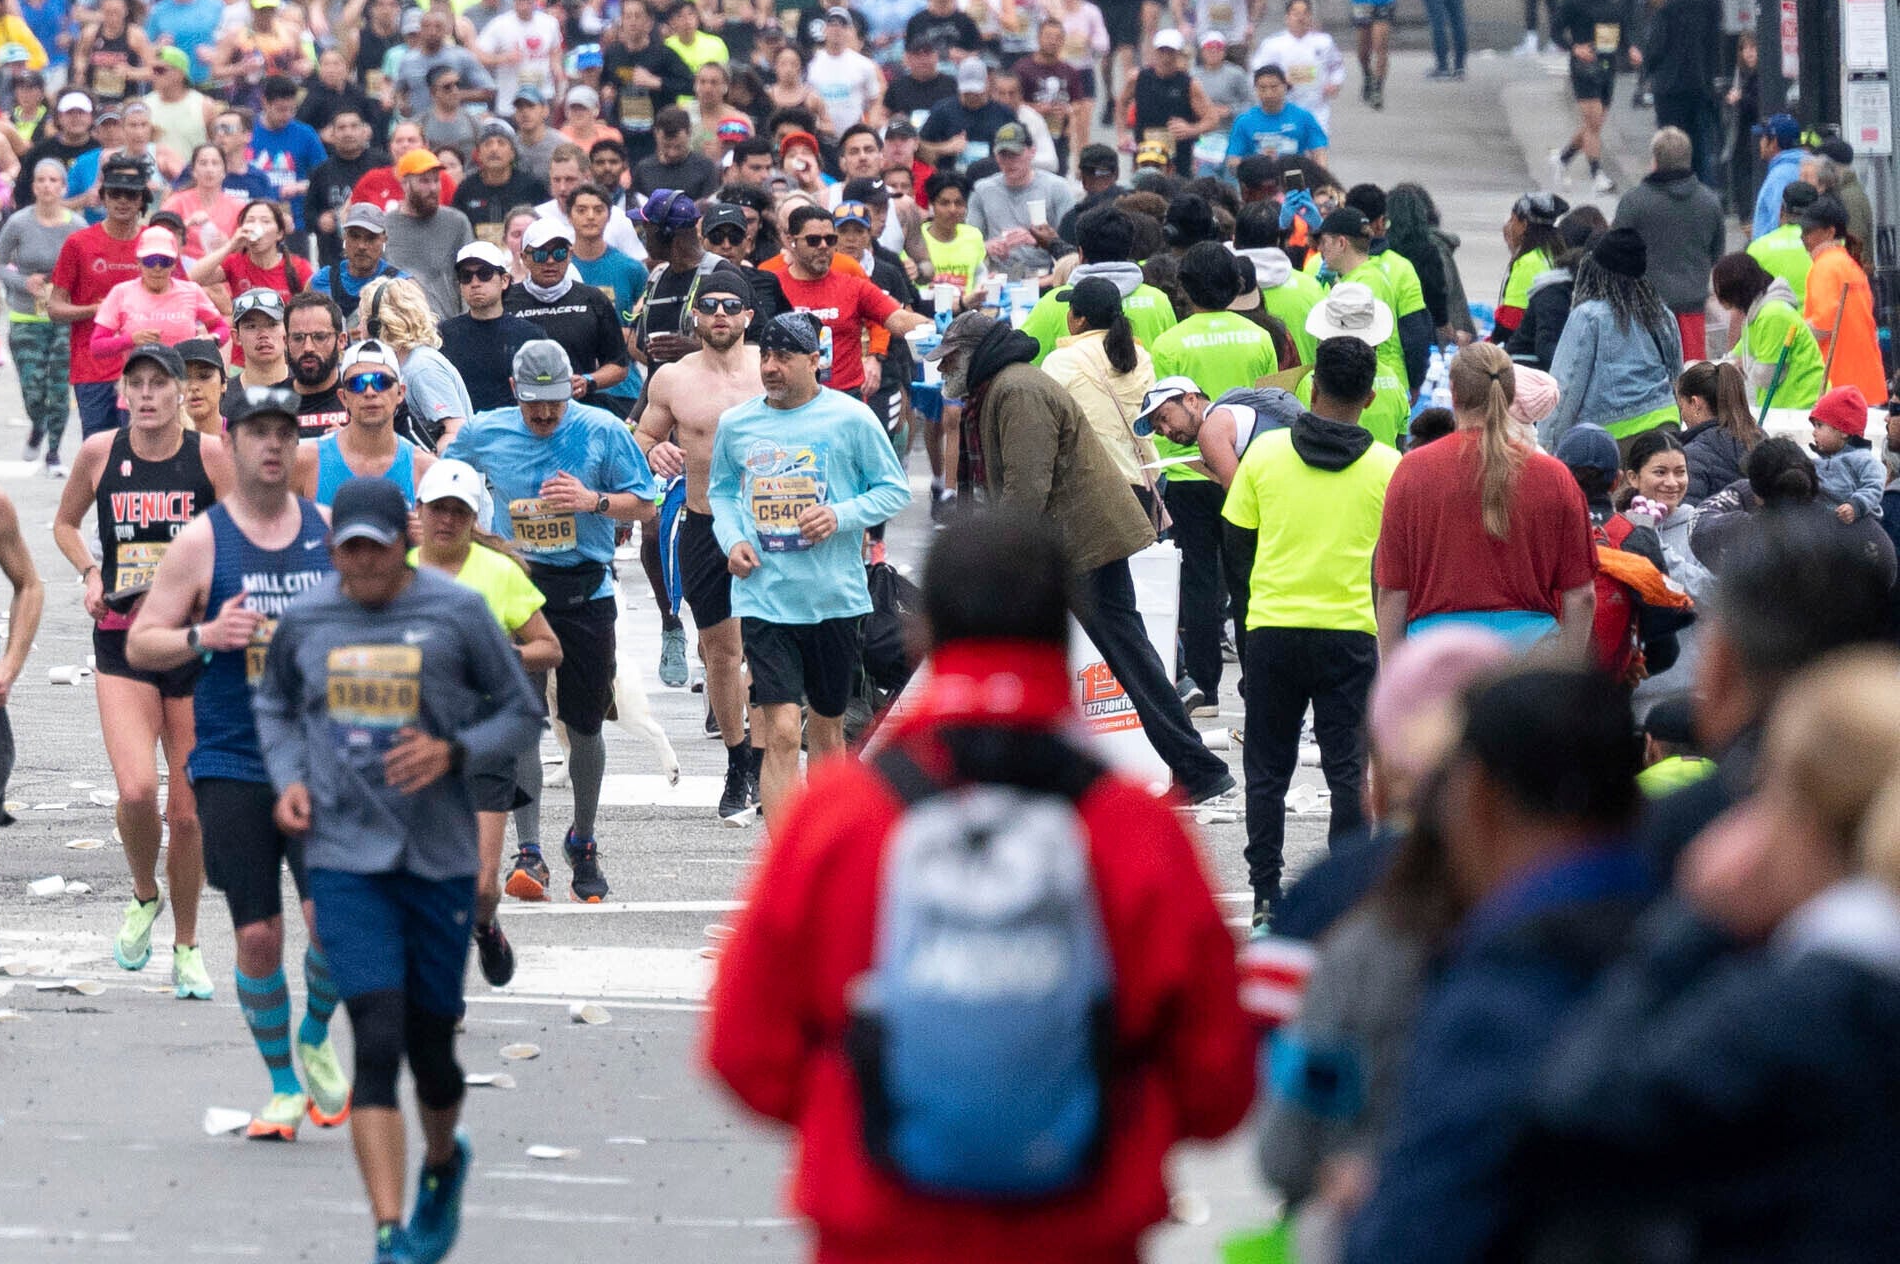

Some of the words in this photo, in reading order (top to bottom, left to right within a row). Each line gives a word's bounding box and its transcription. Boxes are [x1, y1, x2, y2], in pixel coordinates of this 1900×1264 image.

[1181, 330, 1261, 349] VOLUNTEER
[110, 491, 195, 528] VENICE
[517, 521, 571, 540] 12296
[242, 573, 284, 593] MILL
